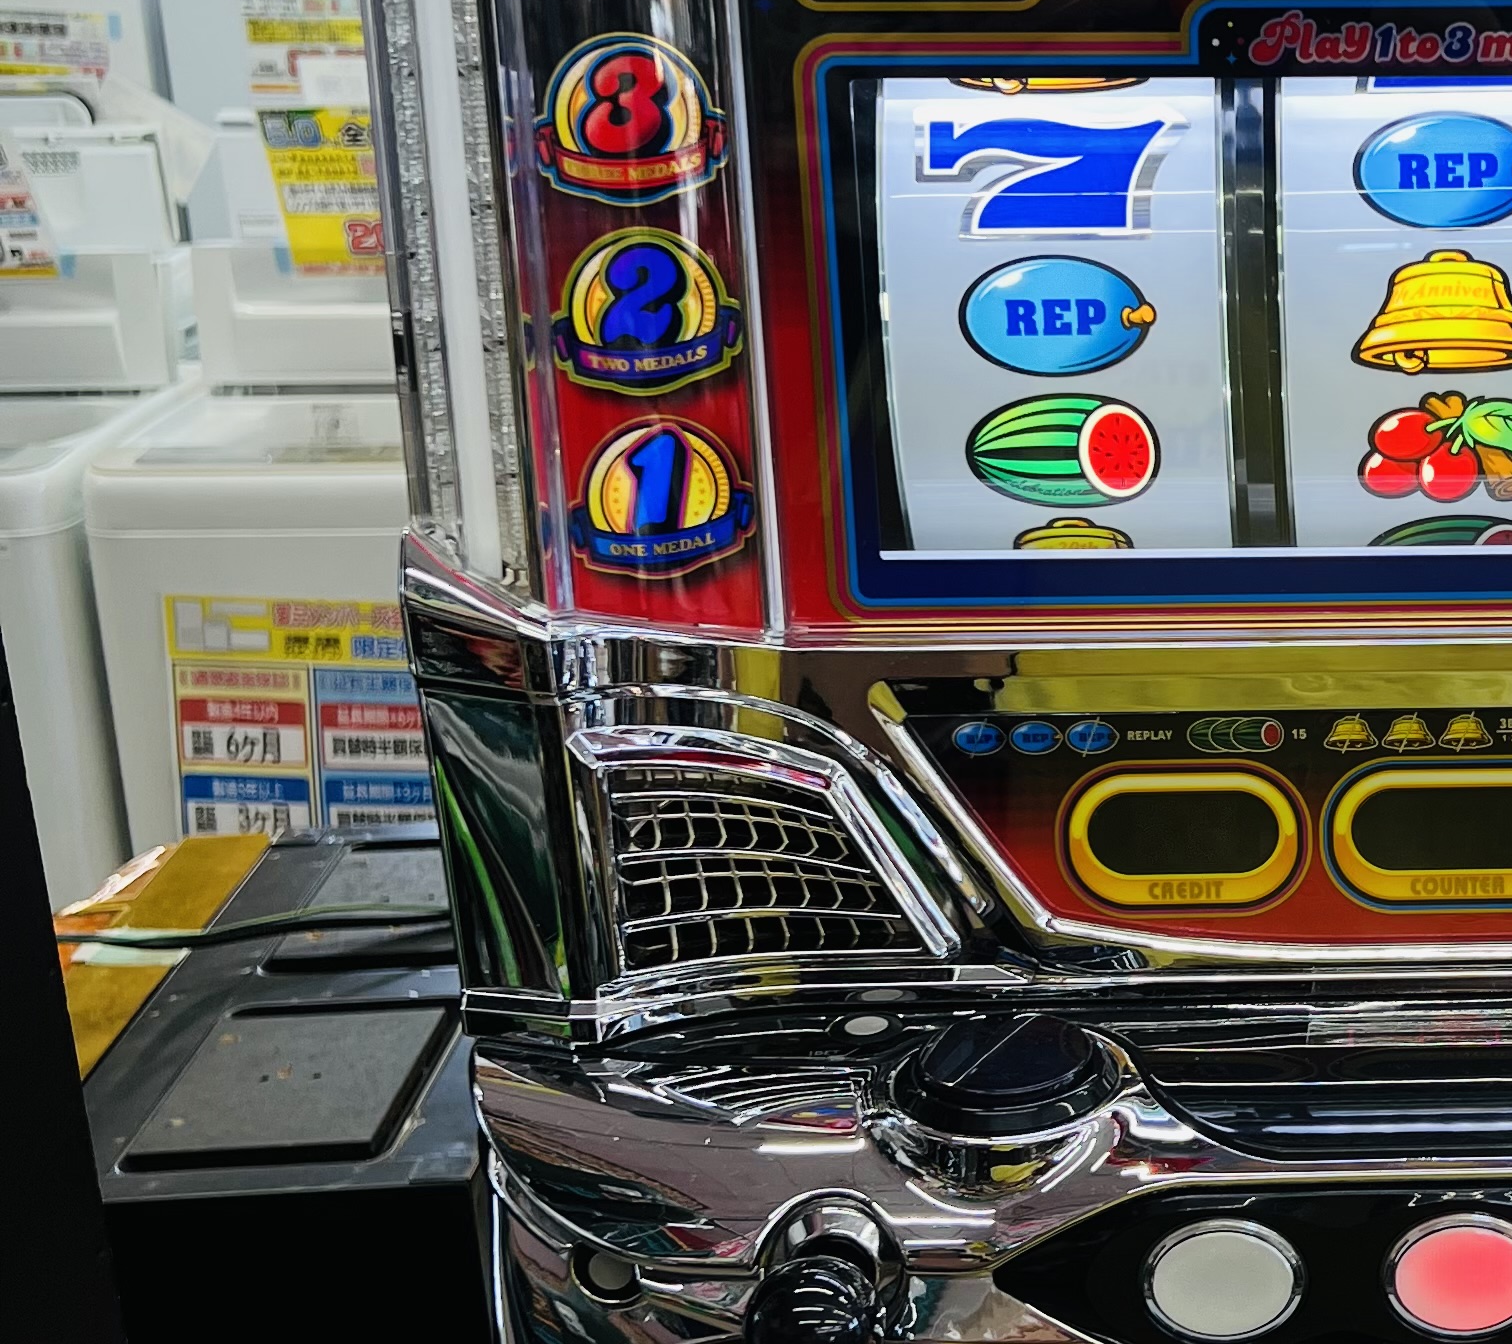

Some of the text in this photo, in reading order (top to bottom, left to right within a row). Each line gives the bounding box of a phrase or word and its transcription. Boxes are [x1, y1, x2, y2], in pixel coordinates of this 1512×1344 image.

[1249, 9, 1374, 66] Play
[1375, 22, 1397, 63] 1
[1396, 26, 1442, 64] to
[1442, 21, 1475, 63] 3
[584, 54, 663, 154] 3
[1396, 150, 1499, 191] REP
[602, 246, 681, 347] 2
[1004, 298, 1106, 338] REP
[588, 346, 708, 374] TWO MEDALS
[631, 432, 676, 533] 1
[609, 530, 715, 559] ONE MEDAL
[1126, 729, 1173, 741] REPLAY
[1291, 728, 1307, 740] 15
[1148, 881, 1224, 900] CREDIT
[1410, 875, 1505, 896] COUNTER
